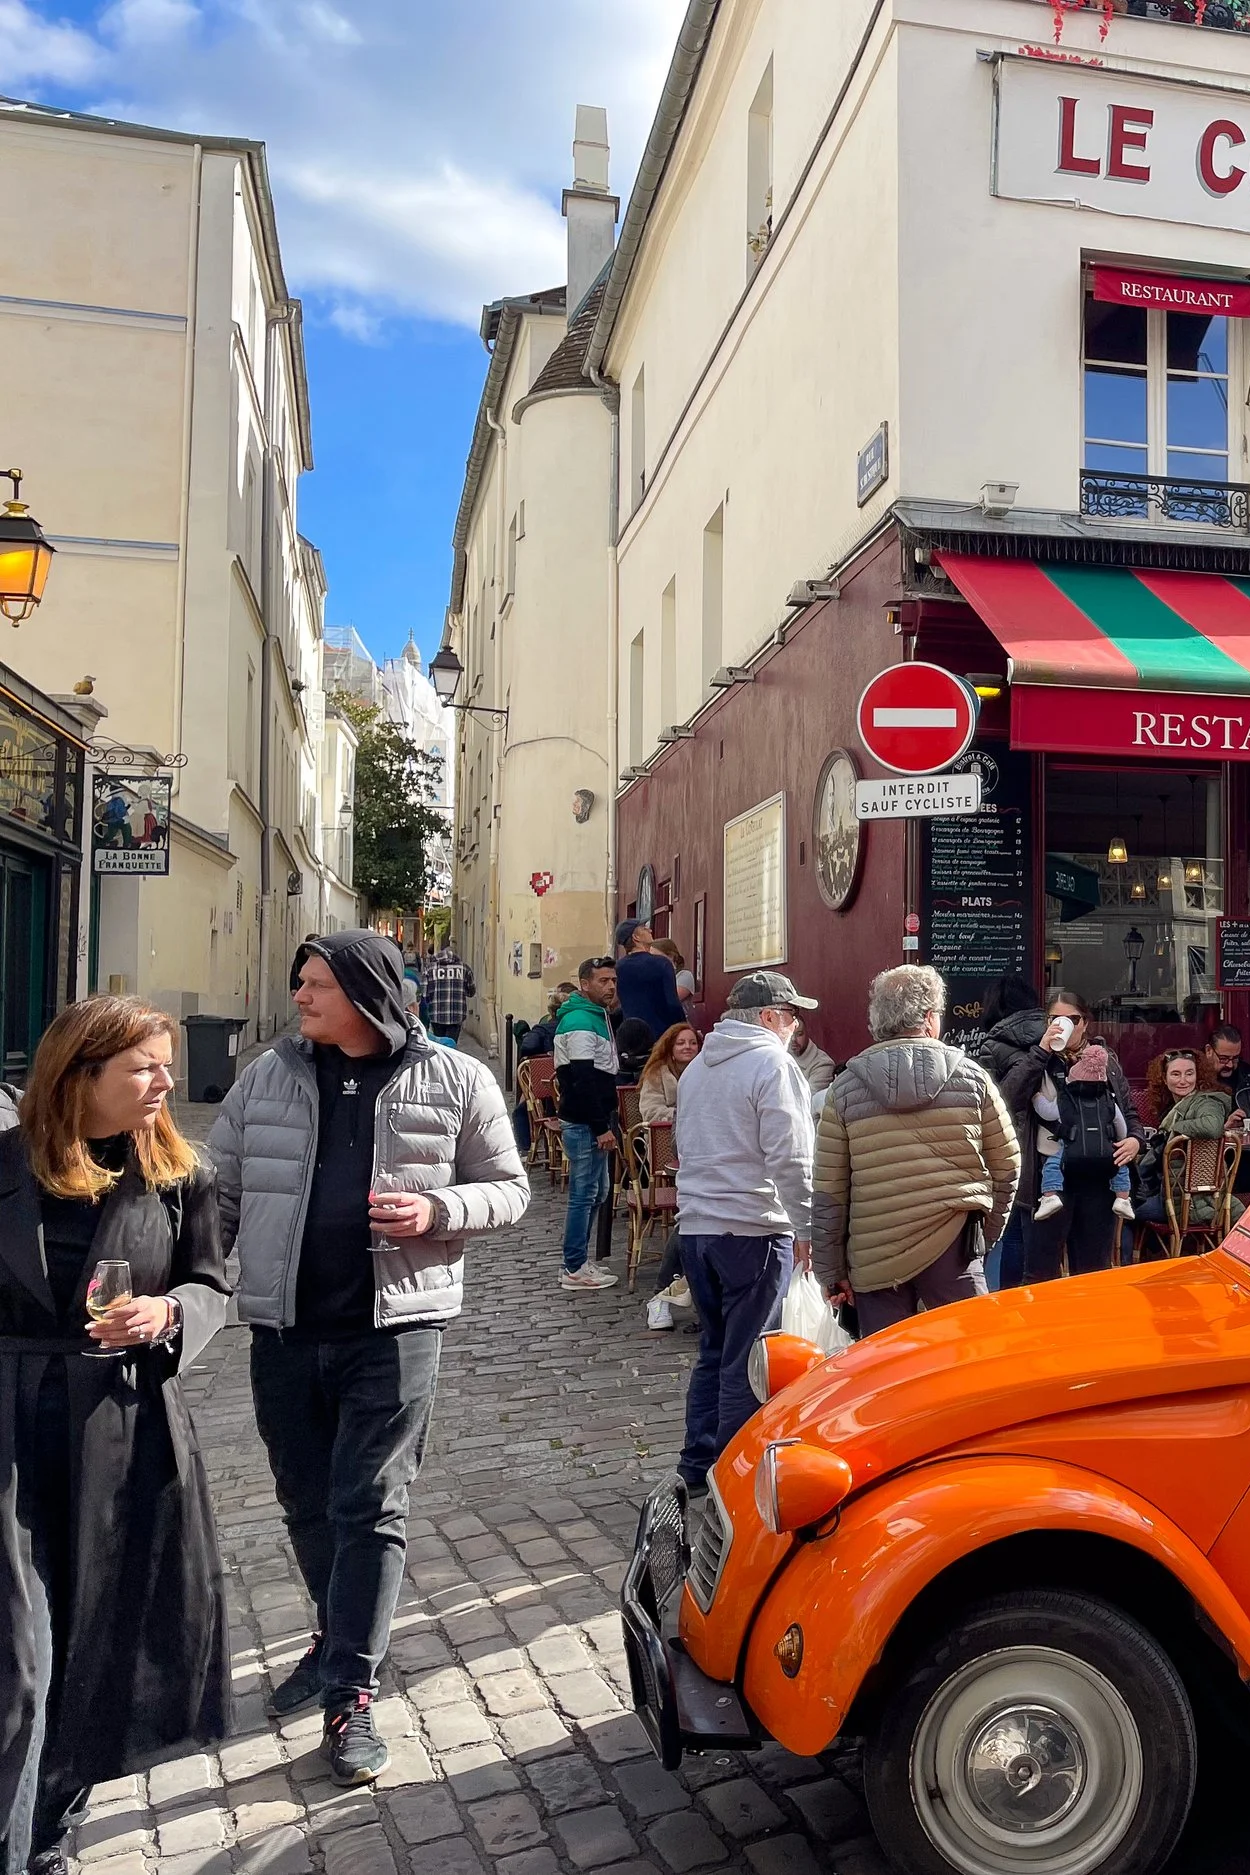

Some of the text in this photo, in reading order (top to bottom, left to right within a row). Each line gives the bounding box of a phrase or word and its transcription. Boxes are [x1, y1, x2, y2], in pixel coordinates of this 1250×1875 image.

[1055, 96, 1154, 183] LE
[1120, 281, 1234, 310] RESTAURANT
[883, 782, 949, 796] INTERDIT
[861, 796, 972, 813] SAUF CYCLISTE
[105, 852, 156, 861] LA BONNE
[98, 860, 162, 870] FRANQUETTE
[961, 896, 992, 907] PLATS
[433, 968, 463, 980] ICON
